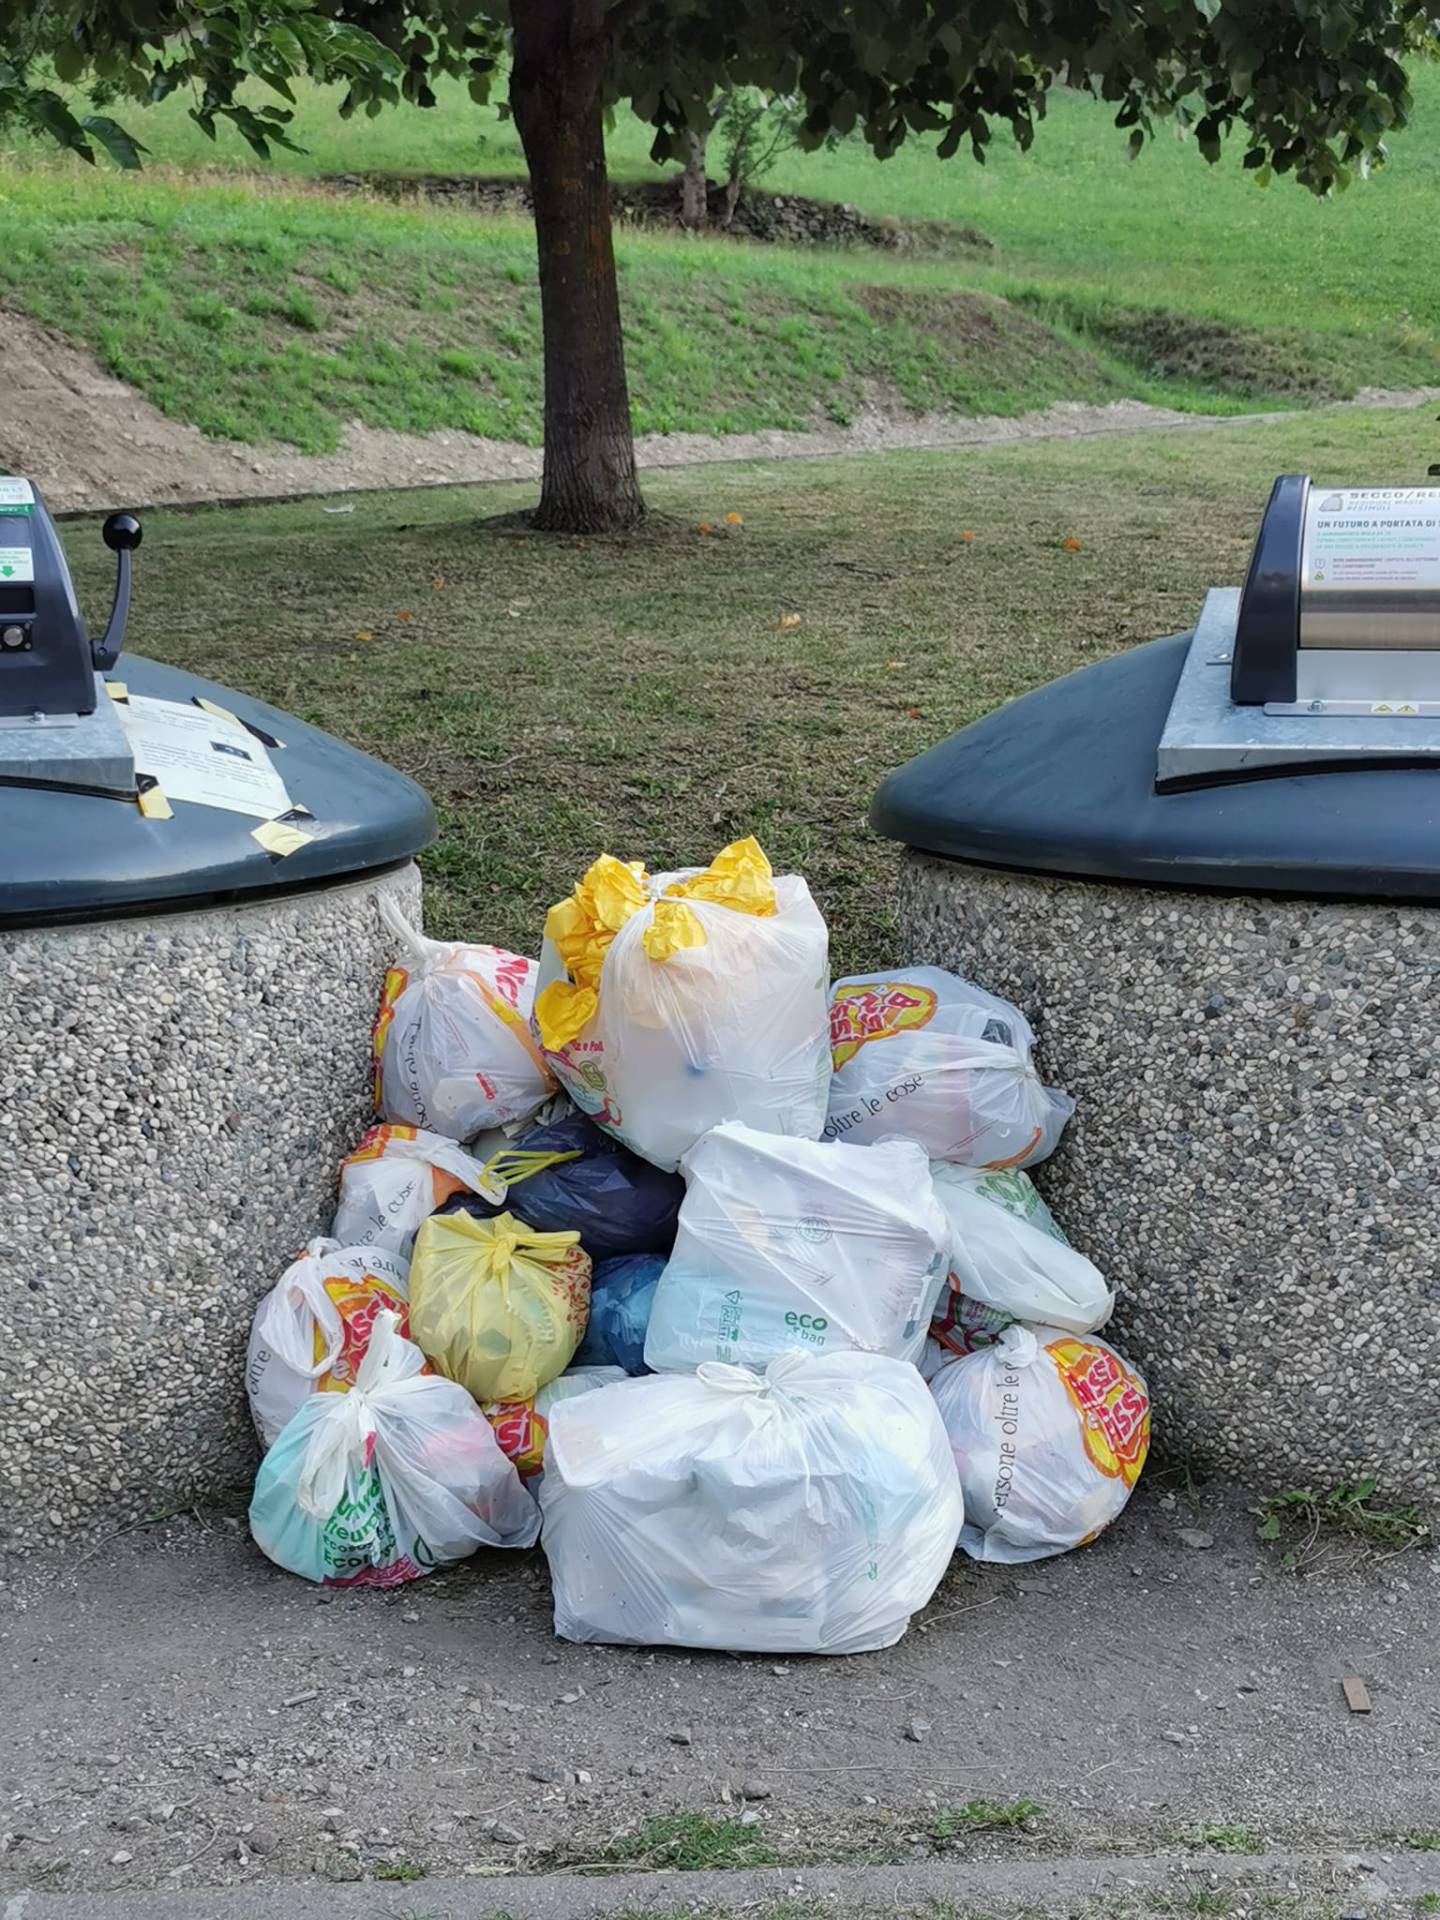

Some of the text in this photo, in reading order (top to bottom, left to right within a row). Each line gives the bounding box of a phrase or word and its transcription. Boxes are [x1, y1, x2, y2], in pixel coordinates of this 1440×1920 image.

[1350, 491, 1440, 499] SECCO/RE
[1317, 521, 1331, 529] UN
[1333, 520, 1370, 529] FUTURO
[1371, 520, 1378, 528] A
[1380, 520, 1423, 528] PORTATA
[1425, 520, 1436, 528] DI
[823, 1075, 926, 1139] oltre le cose
[784, 1310, 828, 1332] eco
[801, 1329, 826, 1347] bag
[996, 1373, 1020, 1396] le
[994, 1391, 1019, 1436] oltre
